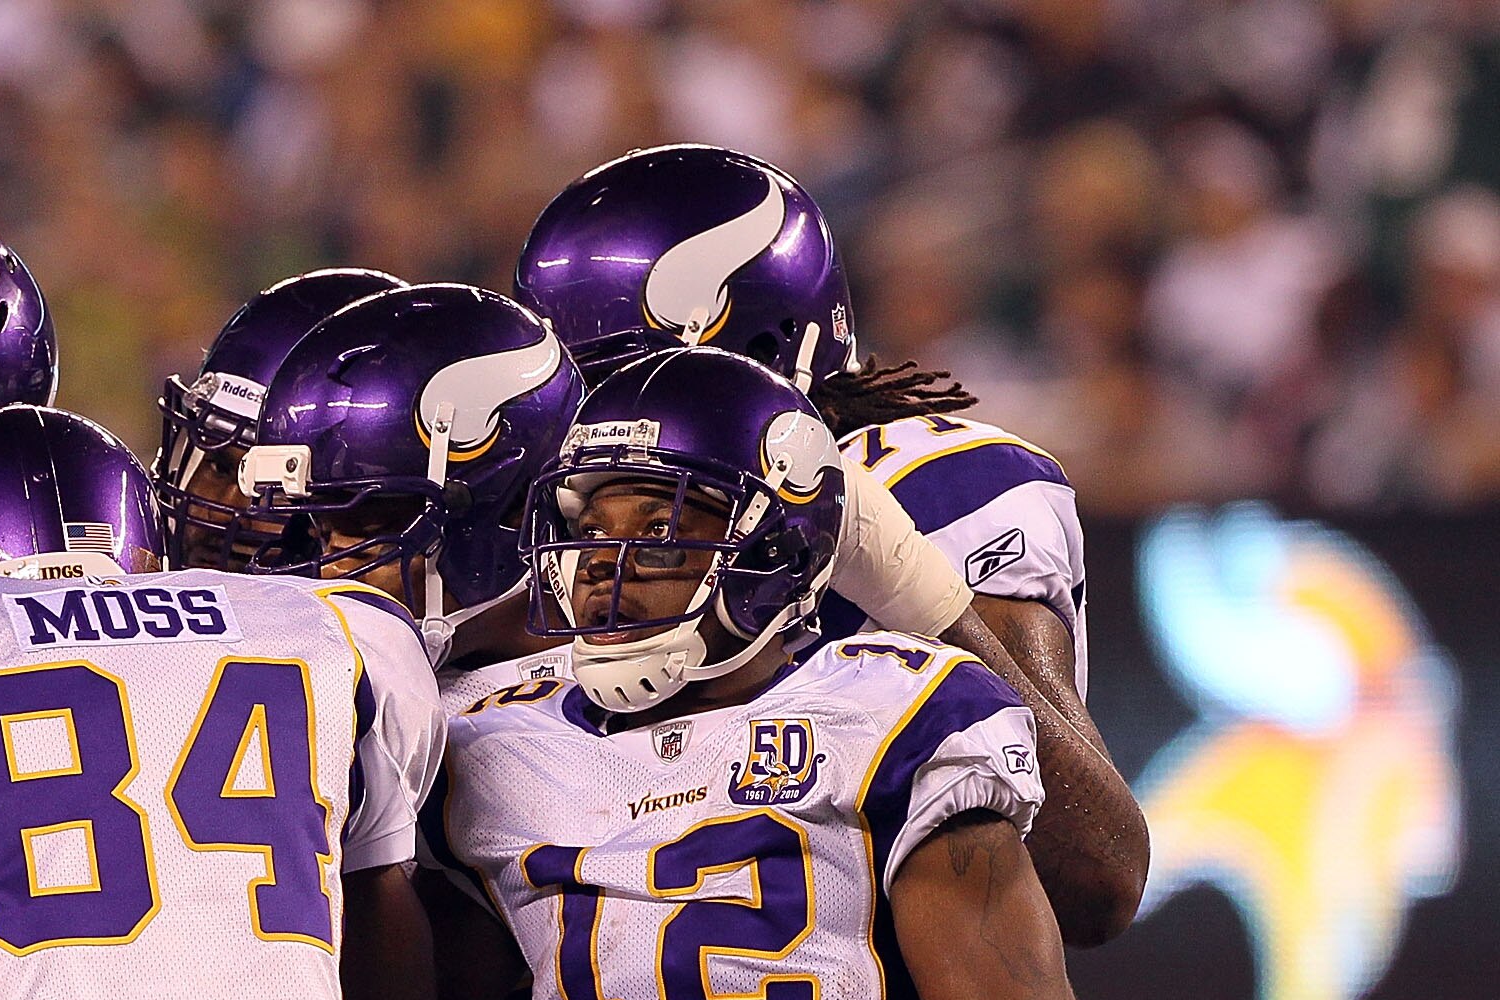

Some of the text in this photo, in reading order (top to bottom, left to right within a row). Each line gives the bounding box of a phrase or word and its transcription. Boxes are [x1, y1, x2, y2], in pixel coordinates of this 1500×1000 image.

[547, 550, 566, 601] iddell
[14, 588, 228, 646] MOSS
[662, 742, 682, 757] NFL
[751, 723, 809, 776] 50
[745, 789, 800, 801] 1961 2010
